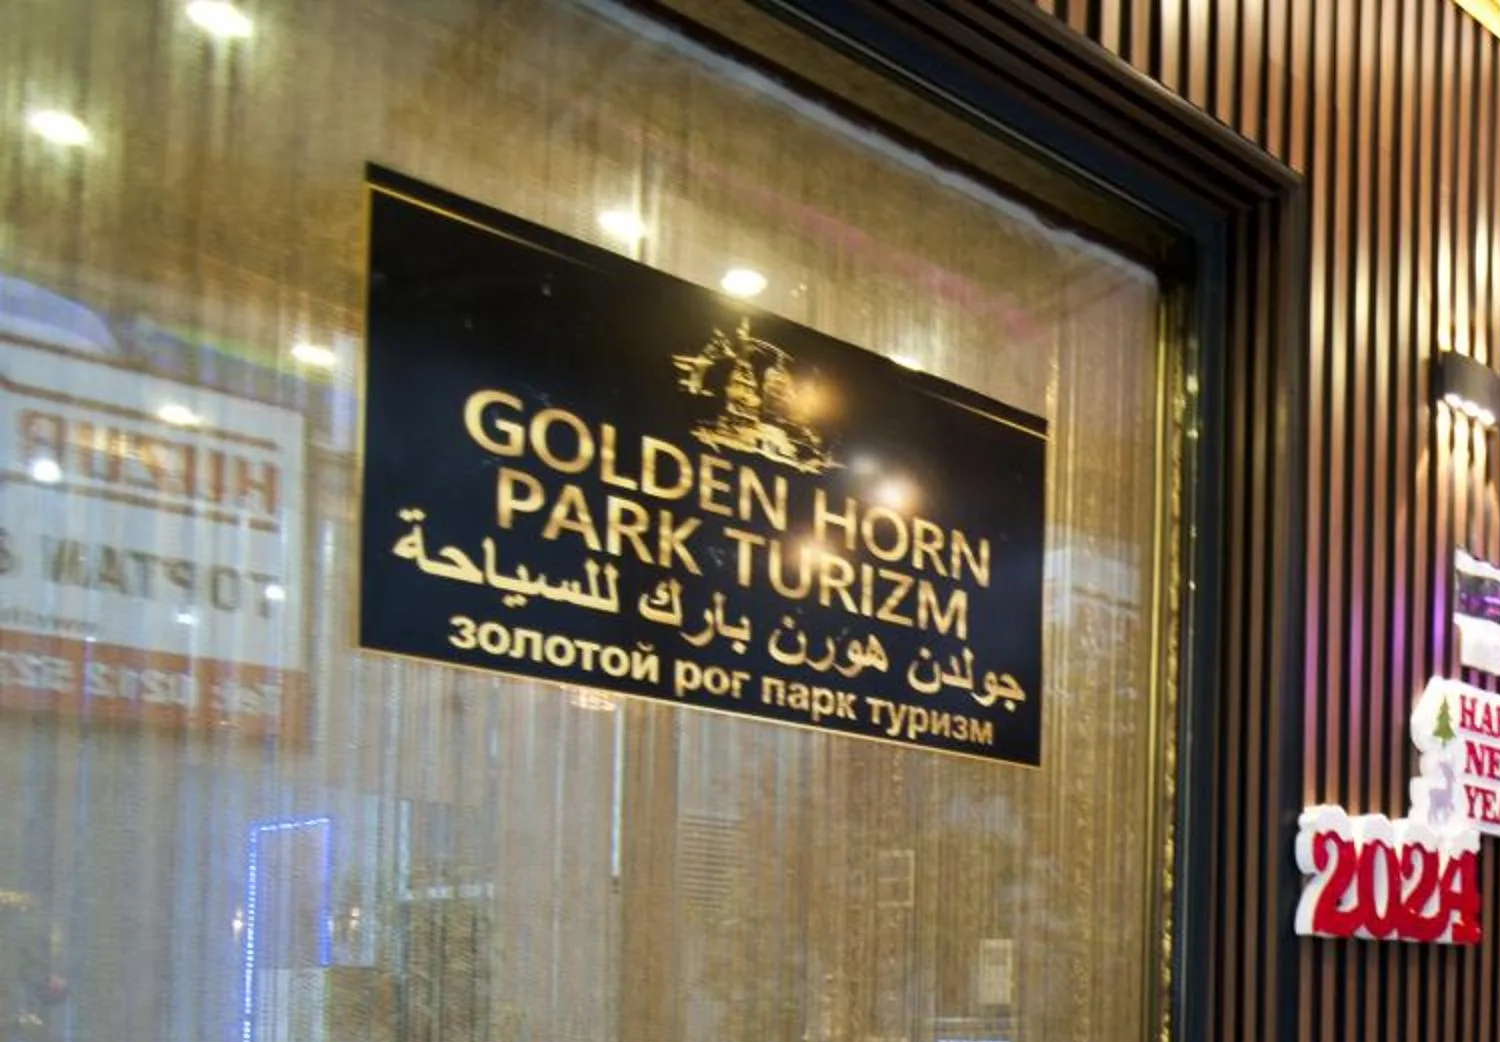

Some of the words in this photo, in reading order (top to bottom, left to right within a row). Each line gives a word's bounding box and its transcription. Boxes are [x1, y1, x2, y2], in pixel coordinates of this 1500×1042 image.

[463, 389, 788, 531] GOLDEN
[814, 488, 991, 588] HORN
[393, 508, 620, 613] للسياحة
[496, 466, 704, 576] PARK
[723, 527, 968, 638] TURIZM
[638, 577, 752, 655] بارك
[767, 614, 890, 679] هورن
[448, 615, 660, 684] золотой
[673, 660, 751, 697] рог
[761, 675, 858, 722] парк
[865, 696, 994, 746] туризм
[907, 646, 1026, 711] جولدن
[1311, 829, 1483, 946] 2024
